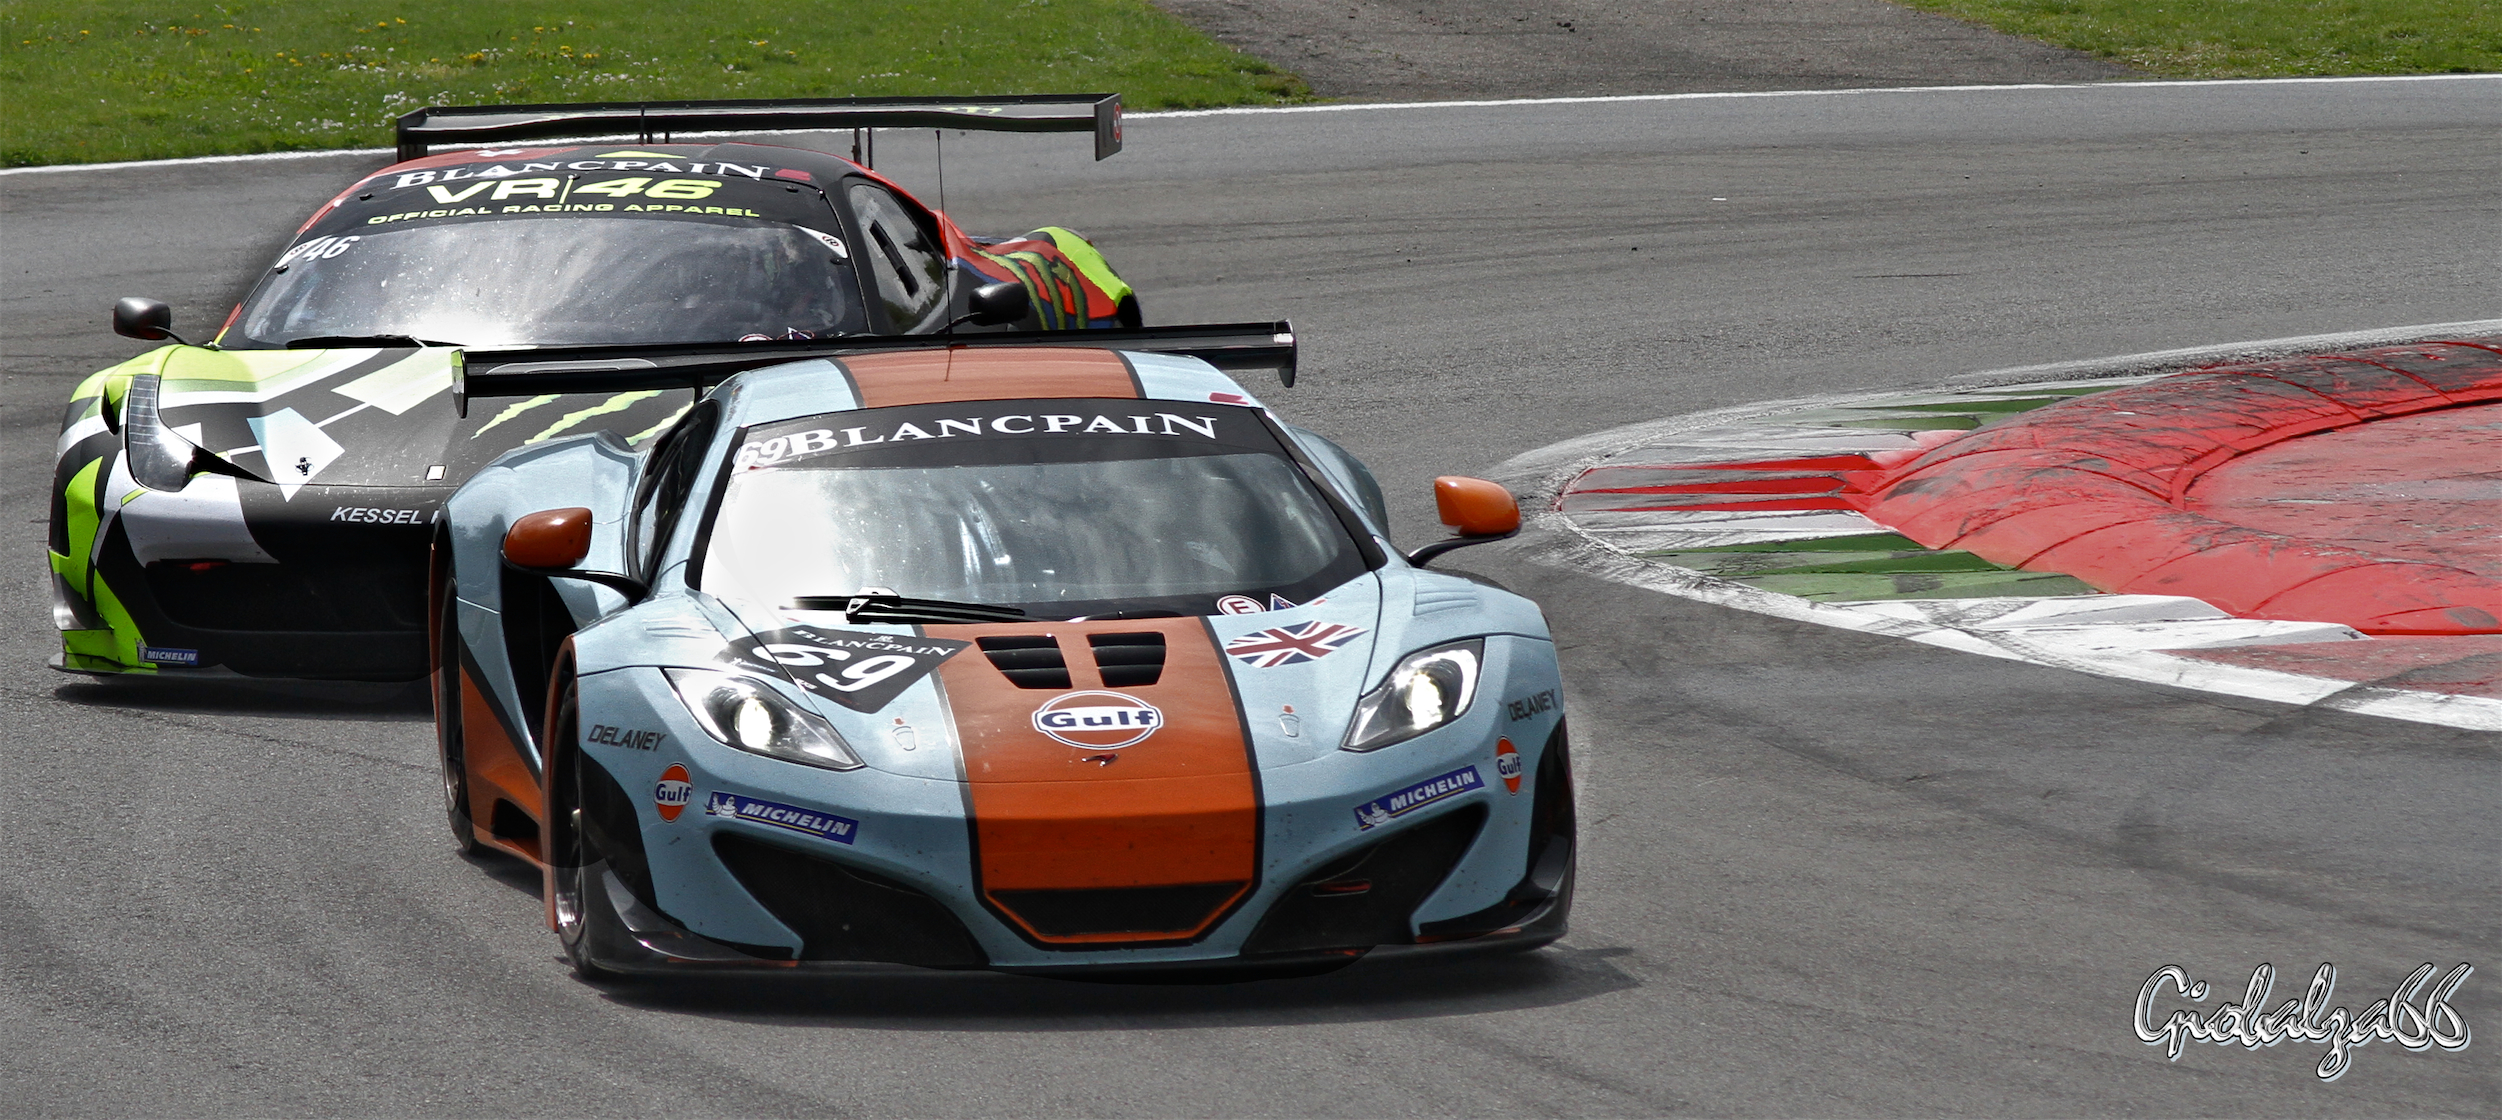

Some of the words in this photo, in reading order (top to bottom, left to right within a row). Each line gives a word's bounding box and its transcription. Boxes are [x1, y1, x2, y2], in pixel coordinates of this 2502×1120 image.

[389, 160, 770, 190] BLANCPAIN
[367, 206, 492, 224] OFFICIAL
[502, 203, 614, 213] RACING
[623, 204, 760, 217] APPAREL
[302, 235, 361, 262] 46
[782, 413, 1217, 457] BLANCPAIN
[737, 438, 788, 465] 69
[330, 506, 423, 525] KESSEL
[147, 650, 197, 661] MICHELIN
[792, 629, 956, 657] BLANCPAIN
[752, 643, 916, 692] 69
[1041, 710, 1154, 728] Gulf
[1508, 689, 1556, 722] DELANEY
[587, 724, 666, 752] DELANEY
[1497, 757, 1520, 776] Gulf
[655, 782, 692, 802] Gulf
[1390, 770, 1477, 812] MICHELIN
[741, 803, 852, 837] MICHELIN
